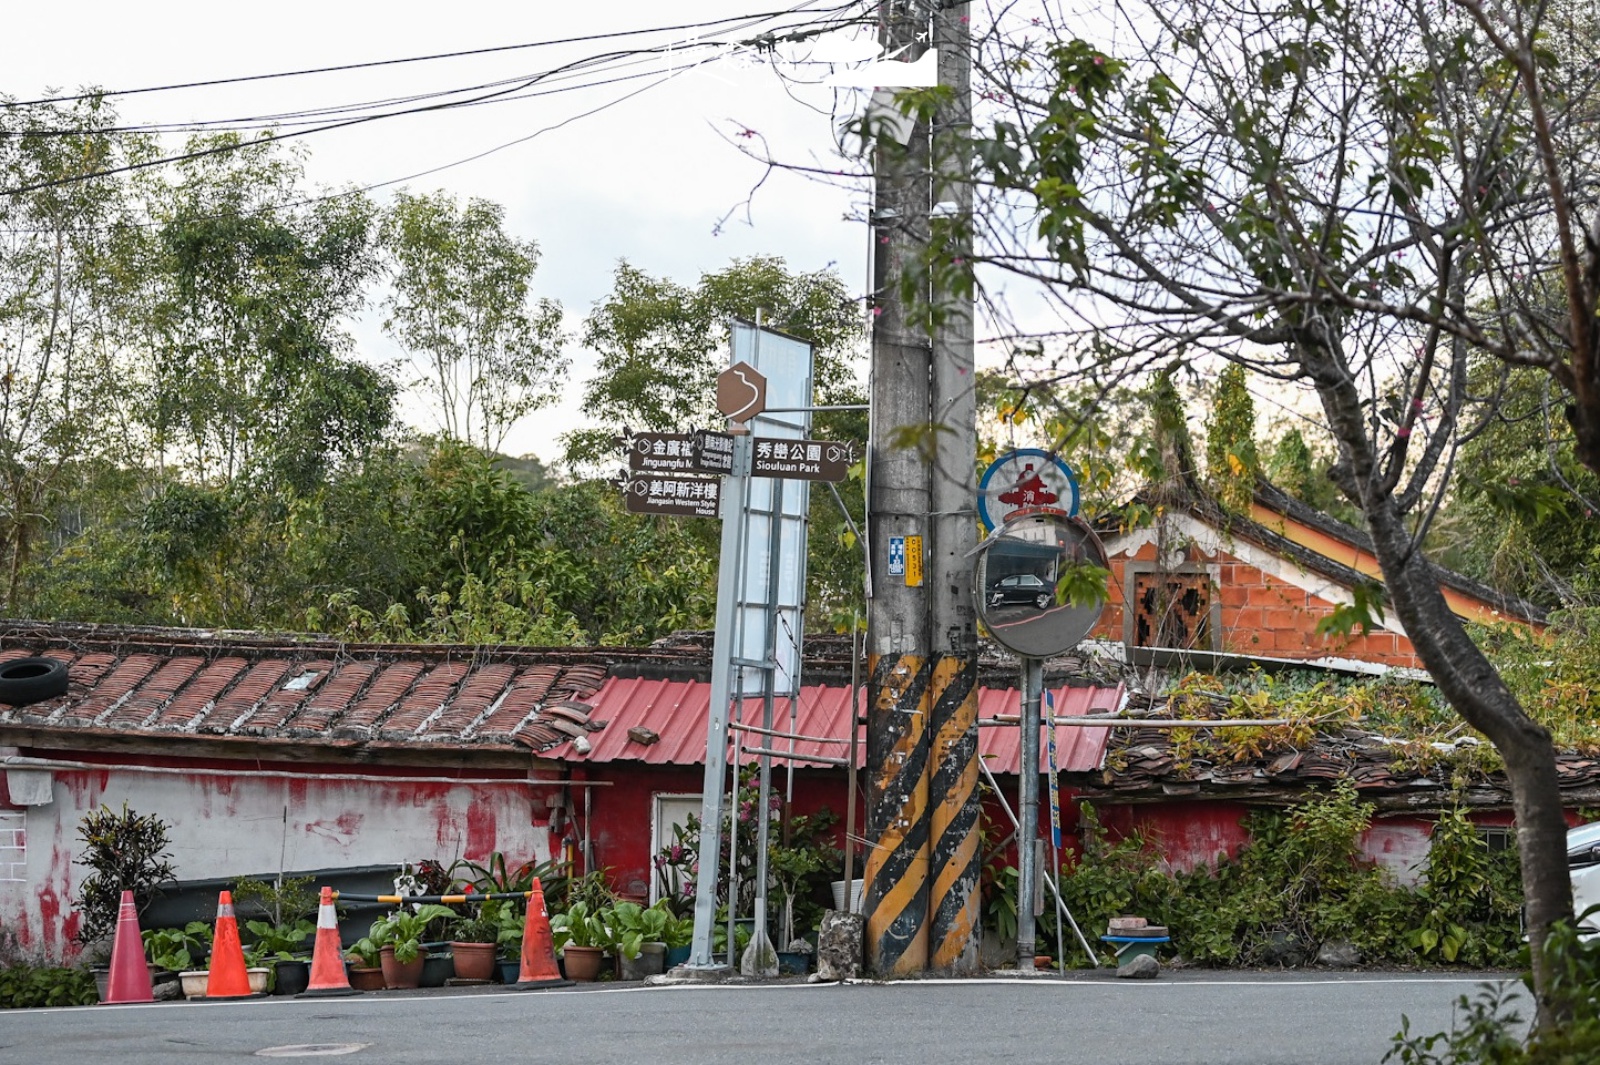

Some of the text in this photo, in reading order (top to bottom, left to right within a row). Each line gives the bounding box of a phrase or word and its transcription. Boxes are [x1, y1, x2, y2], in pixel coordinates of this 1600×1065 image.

[757, 442, 821, 461] 秀巒公園
[642, 457, 684, 469] Jinguangfu
[756, 460, 820, 473] Siouluan Park
[649, 480, 717, 499] 姜阿新洋樓
[675, 498, 700, 506] Western
[700, 499, 716, 509] Style
